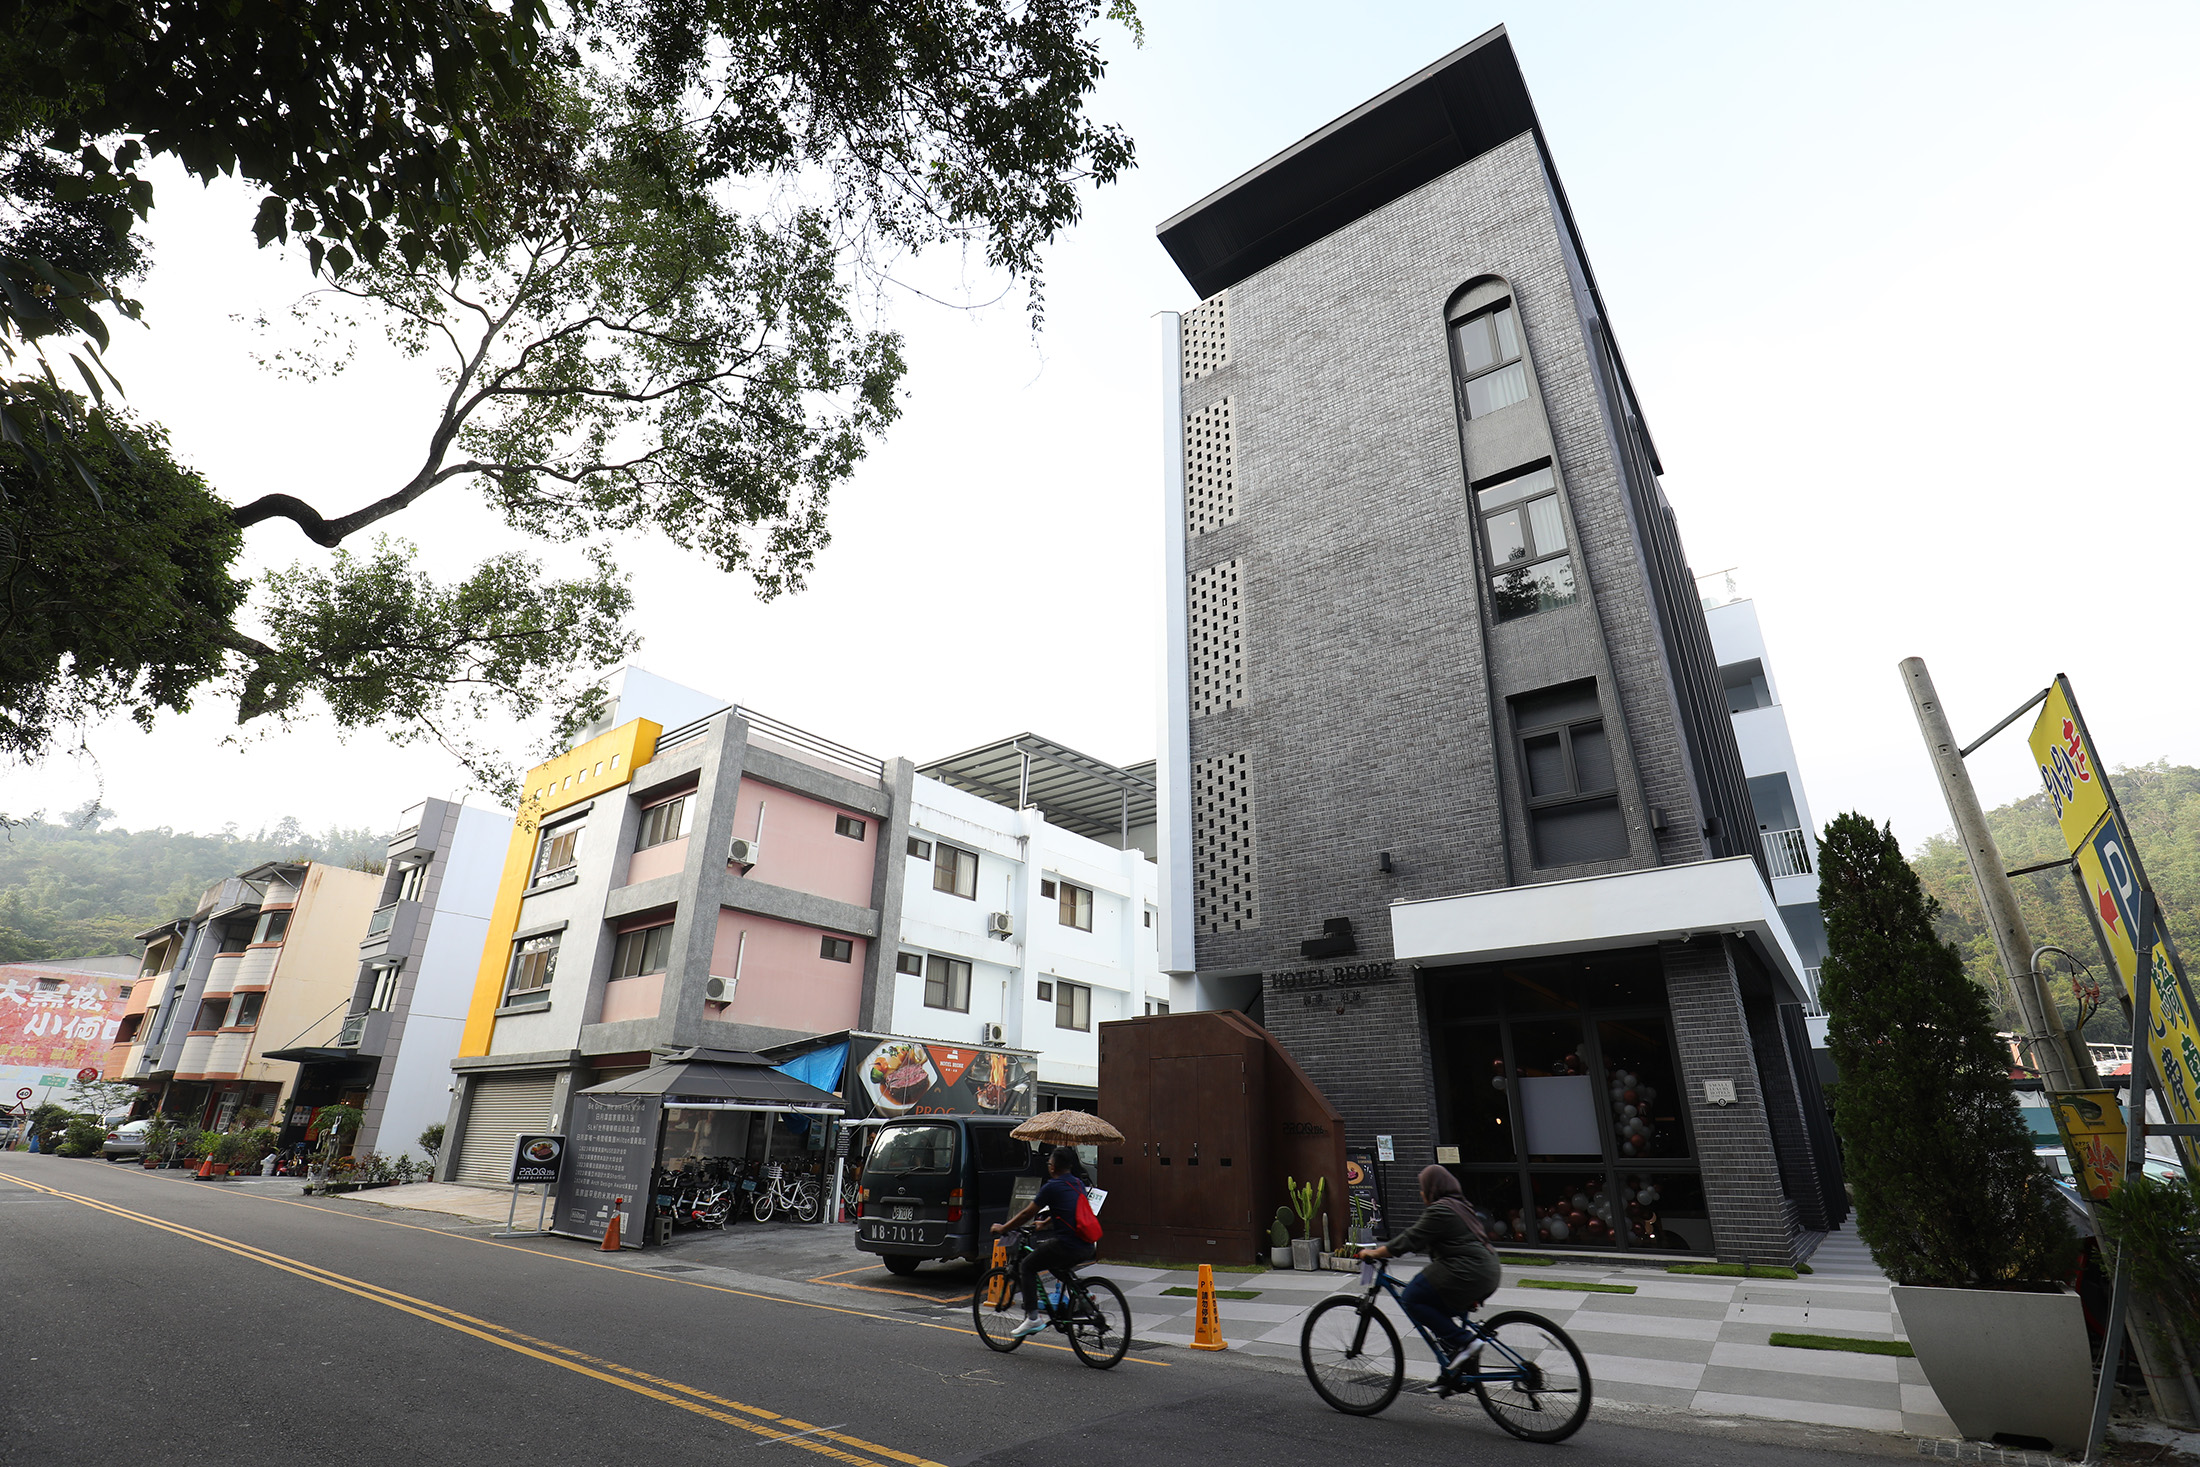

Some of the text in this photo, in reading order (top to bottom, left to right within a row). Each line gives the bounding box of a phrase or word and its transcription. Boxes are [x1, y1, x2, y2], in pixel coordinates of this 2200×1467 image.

[2103, 840, 2139, 938] P
[1271, 962, 1395, 989] HOTEL BEORE
[0, 979, 108, 1012] 大黑松
